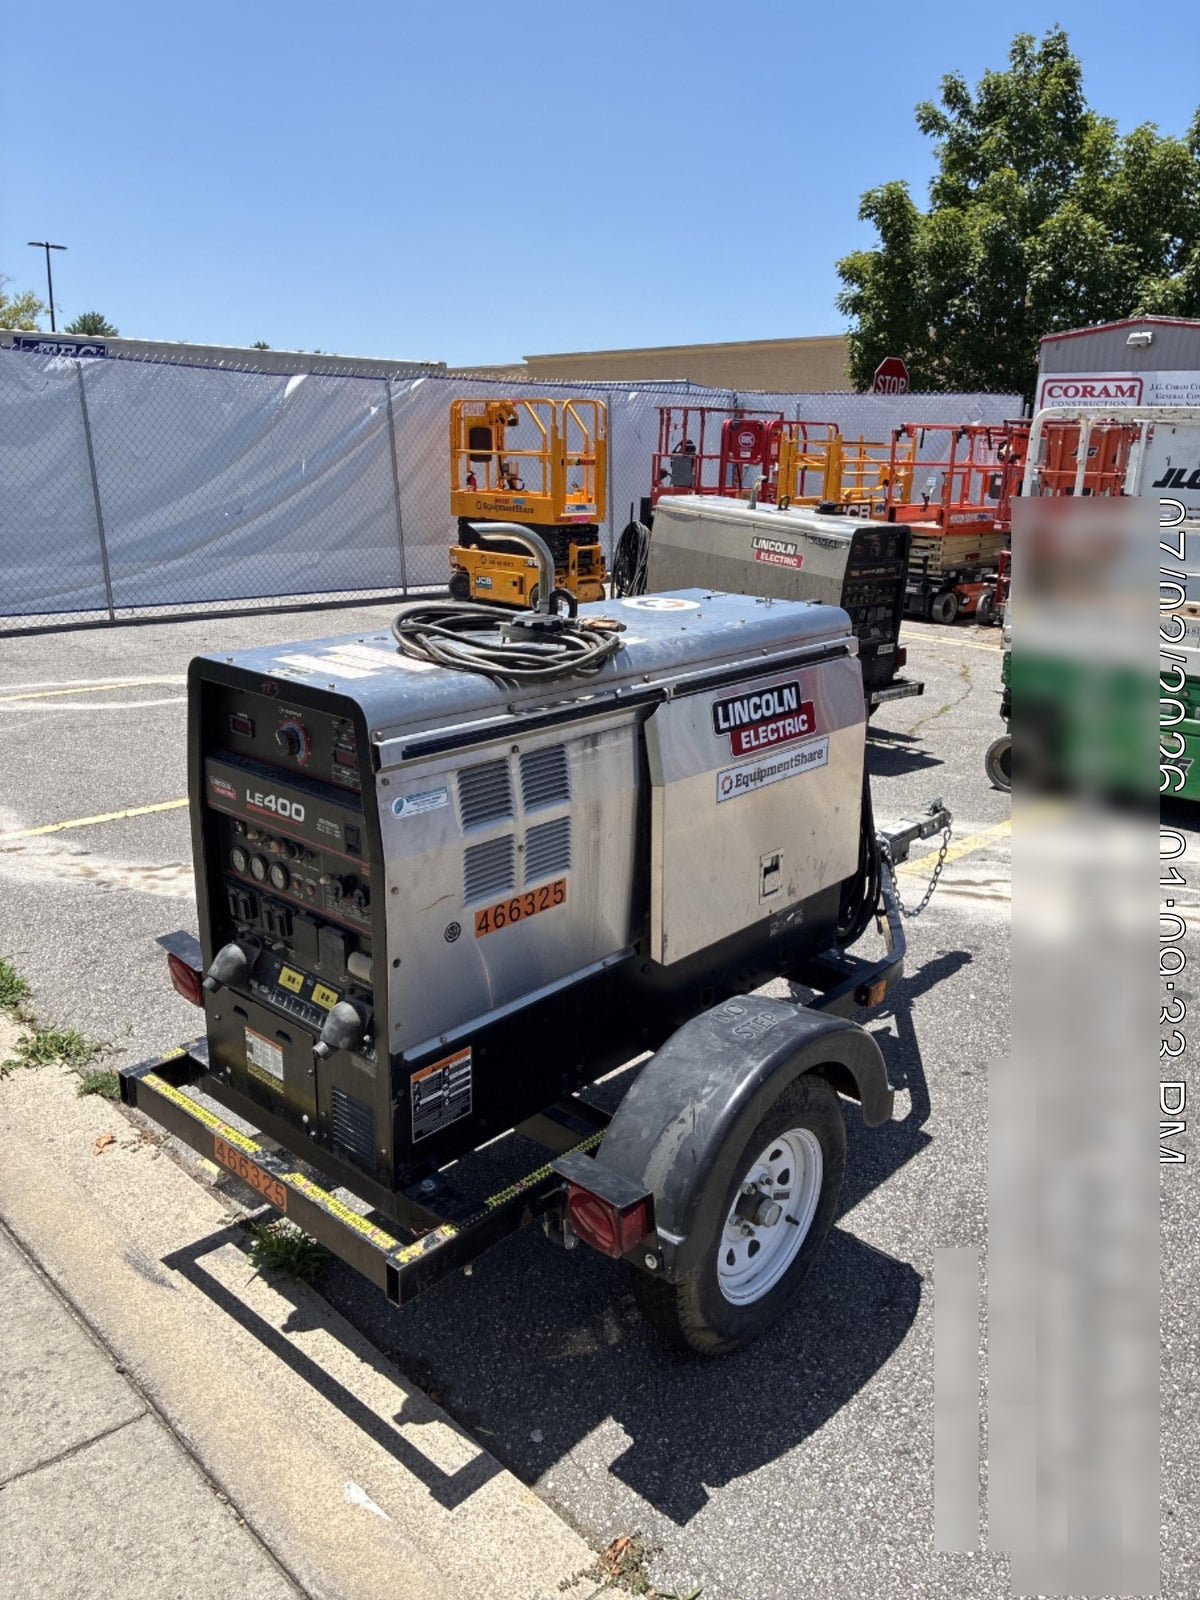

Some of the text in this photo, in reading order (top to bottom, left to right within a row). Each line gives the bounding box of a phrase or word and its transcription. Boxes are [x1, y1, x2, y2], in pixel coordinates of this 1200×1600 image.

[876, 375, 906, 394] STOP
[1047, 384, 1138, 399] CORAM
[752, 538, 796, 555] LINCOLN
[808, 537, 848, 549] VANTA
[760, 552, 798, 566] ELECTRIC
[475, 575, 493, 585] JCB
[717, 685, 798, 730] LINCOLN
[741, 714, 808, 750] ELECTRIC
[734, 748, 824, 789] EquipmentShare
[246, 788, 305, 822] LE400
[477, 880, 564, 933] 466325
[711, 1004, 748, 1023] NO
[733, 1012, 780, 1040] STEP
[216, 1142, 285, 1208] 466325
